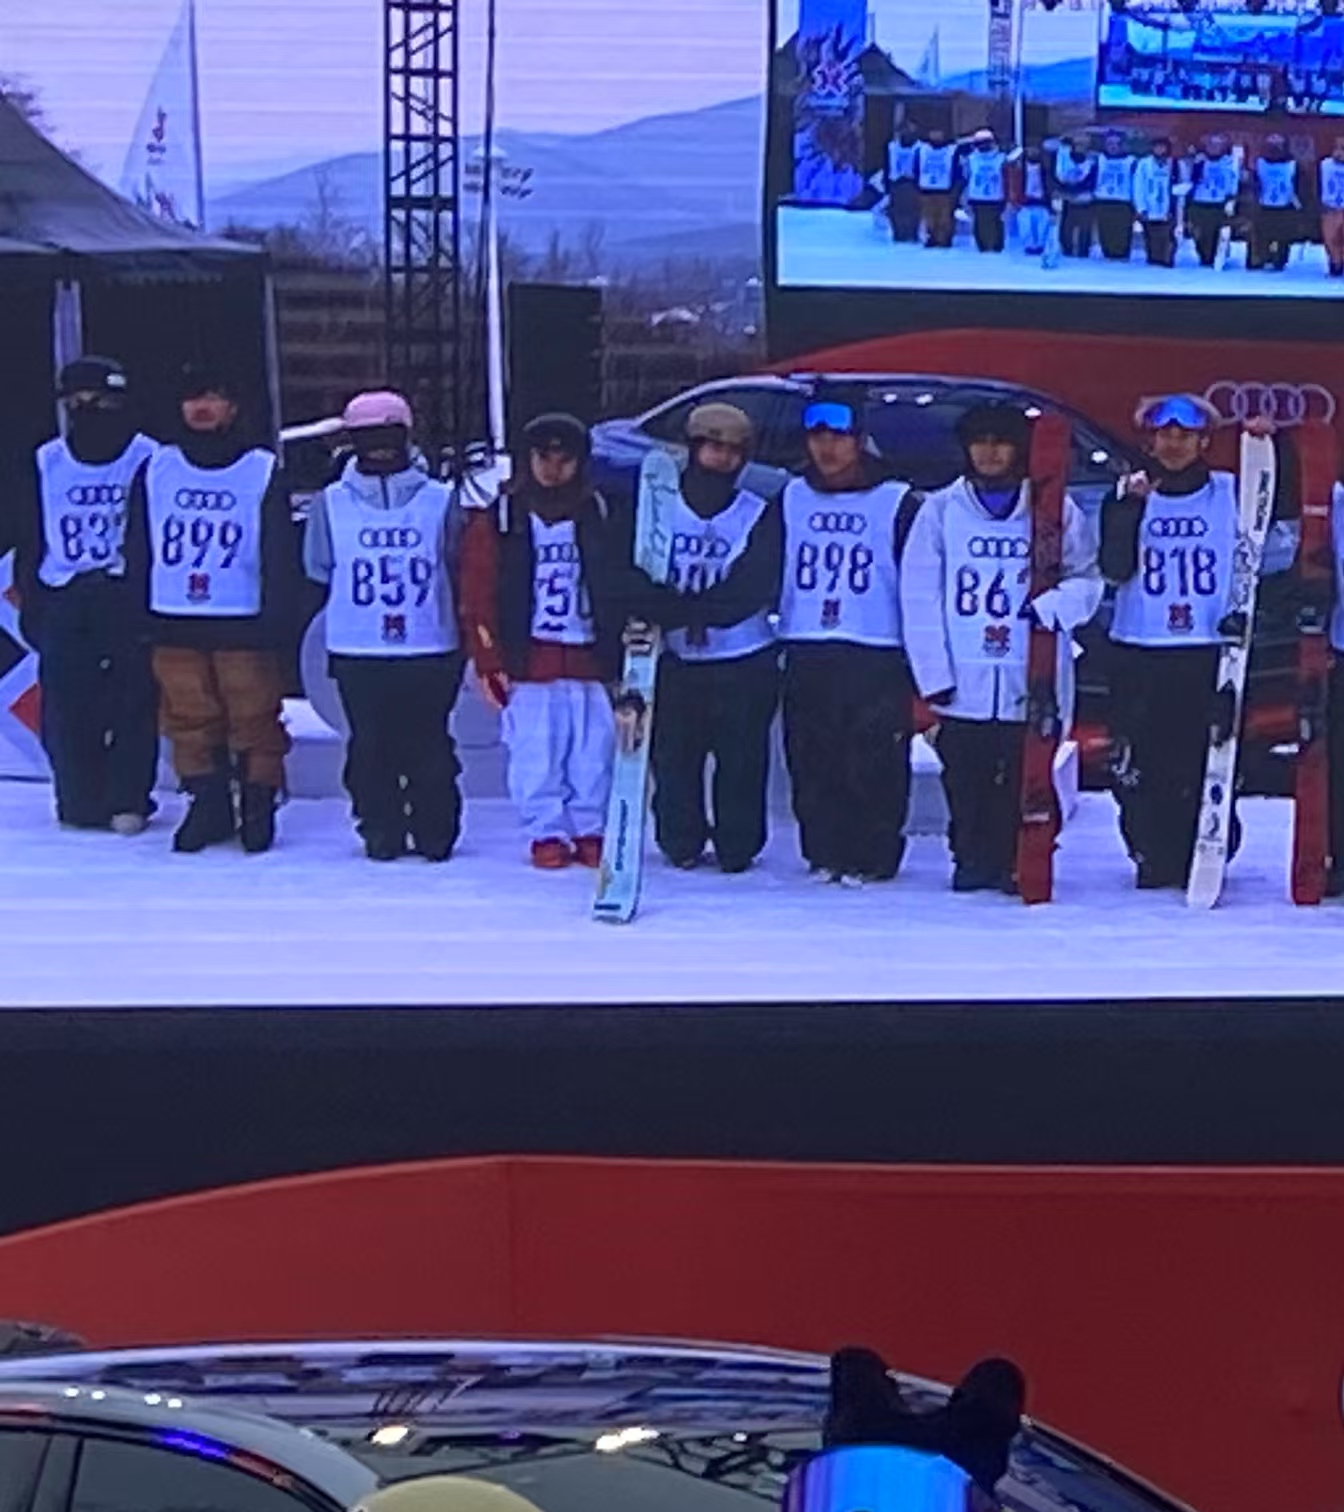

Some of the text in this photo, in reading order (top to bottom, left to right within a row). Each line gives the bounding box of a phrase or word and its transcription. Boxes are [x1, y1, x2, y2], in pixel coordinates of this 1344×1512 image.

[60, 513, 124, 561] 83
[161, 514, 243, 569] 899
[352, 555, 433, 607] 859
[796, 542, 874, 595] 898
[1143, 546, 1217, 597] 818
